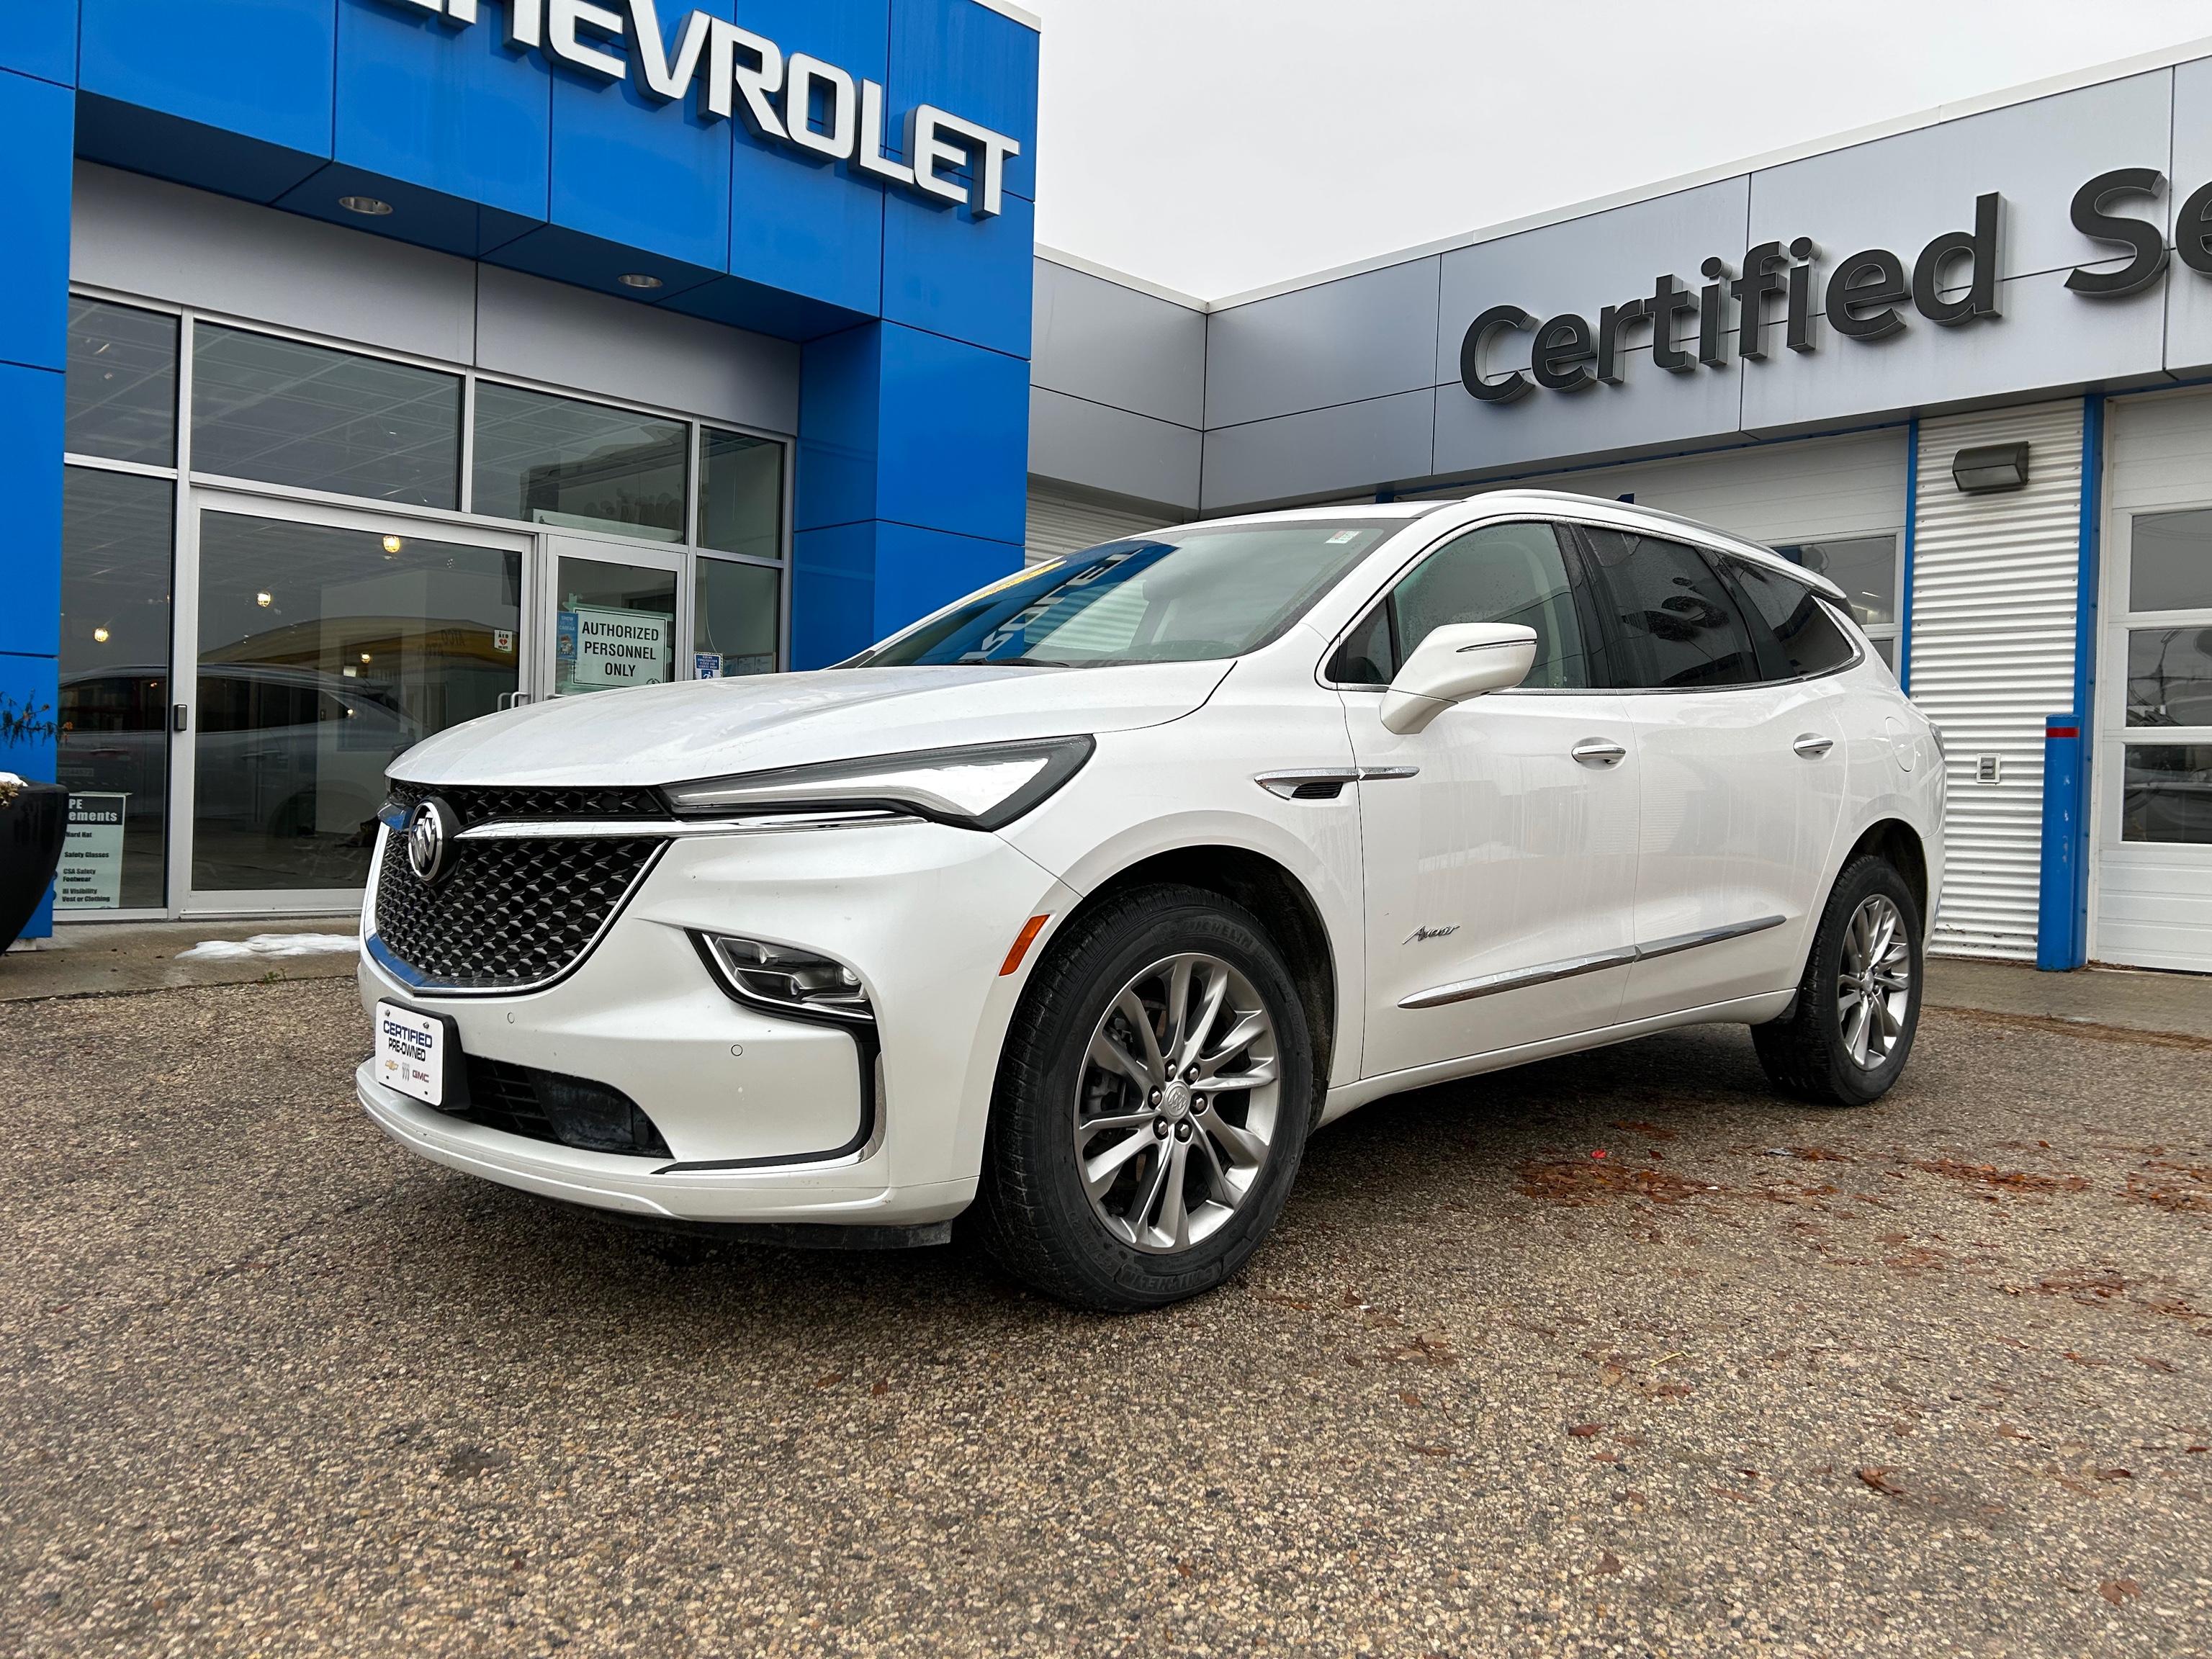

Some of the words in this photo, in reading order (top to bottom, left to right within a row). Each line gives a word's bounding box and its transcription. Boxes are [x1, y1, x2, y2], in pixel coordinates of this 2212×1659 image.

[389, 0, 1020, 218] EVROLET
[1460, 191, 2008, 405] Certified
[582, 621, 659, 641] AUTHORIZED
[584, 641, 657, 660] PERSONNEL
[605, 662, 636, 677] ONLY
[68, 799, 83, 809] PE
[68, 811, 117, 822] ements
[383, 1020, 433, 1048] CERTIFIED
[388, 1037, 426, 1062] PRE-OWNED
[412, 1069, 430, 1083] GMC
